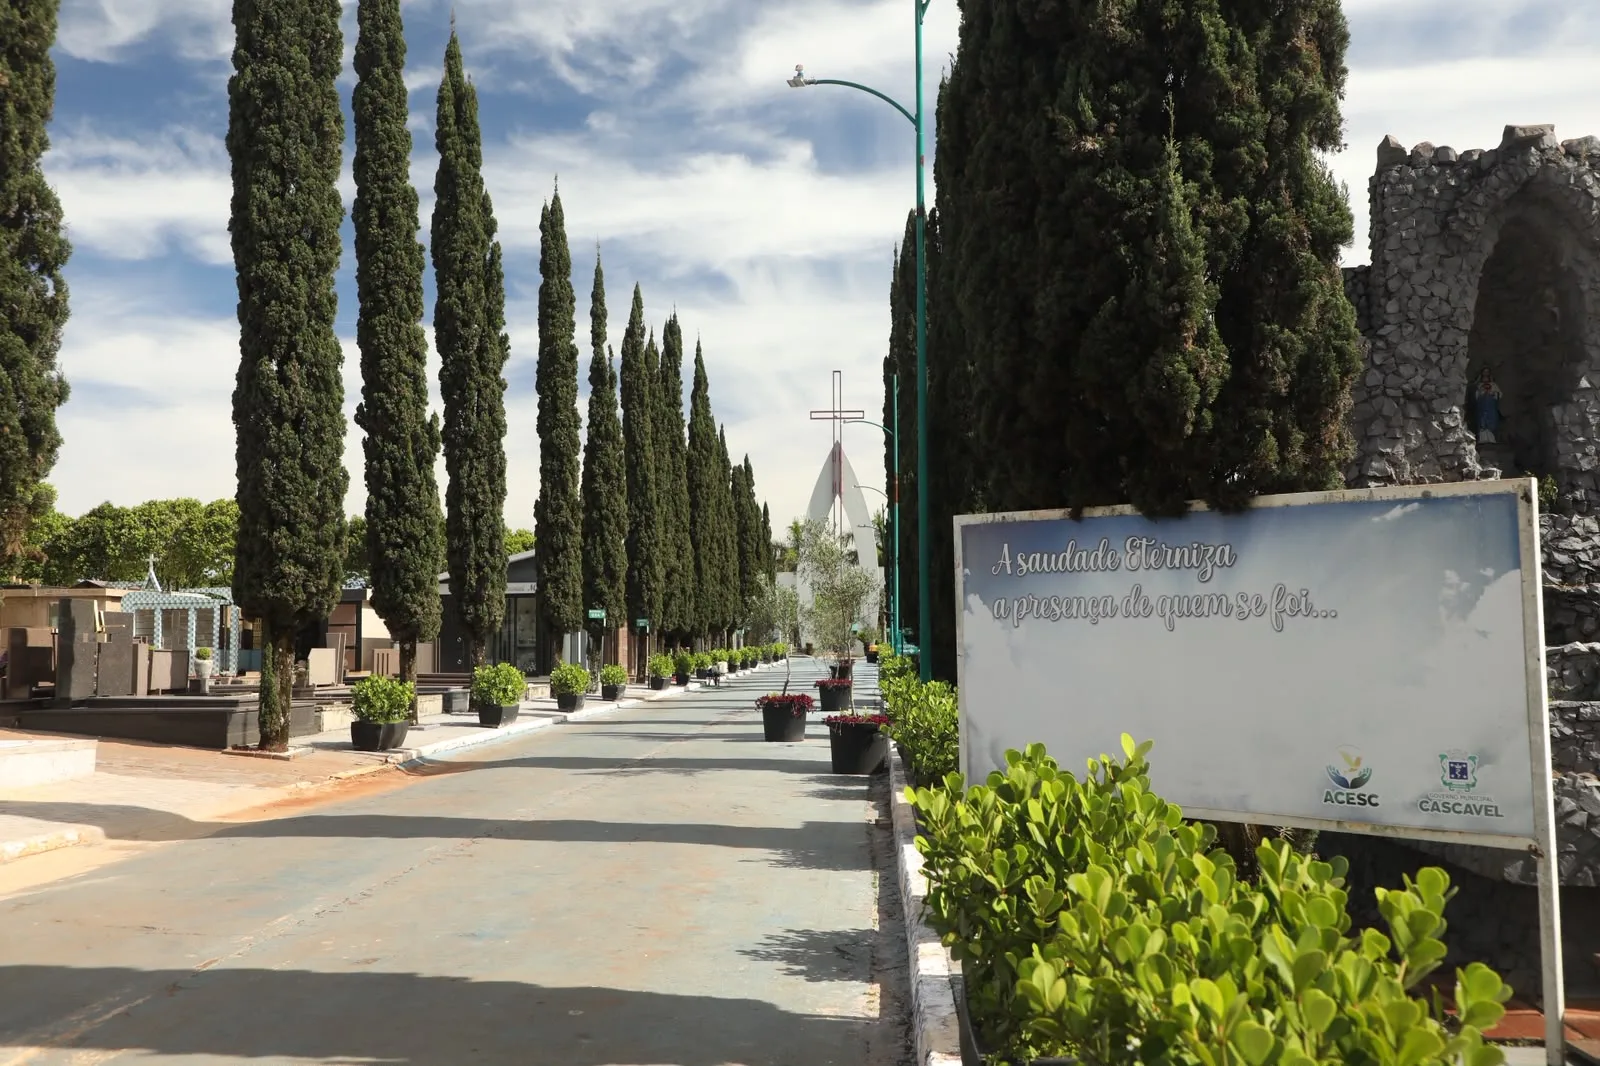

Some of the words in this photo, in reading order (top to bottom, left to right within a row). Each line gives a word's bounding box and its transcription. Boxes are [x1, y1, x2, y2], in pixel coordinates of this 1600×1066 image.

[992, 544, 1012, 575] A
[1016, 538, 1120, 576] saudade
[1125, 536, 1237, 582] Eterniza
[993, 597, 1010, 619] a
[1012, 593, 1118, 628] presença
[1121, 584, 1153, 618] de
[1157, 593, 1233, 632] quem
[1235, 592, 1267, 620] se
[1270, 583, 1338, 632] foi...
[1323, 791, 1379, 807] ACESC
[1430, 792, 1459, 801] GOVERNO
[1460, 794, 1493, 803] MUNICIPAL
[1419, 800, 1505, 817] CASCAVEL
